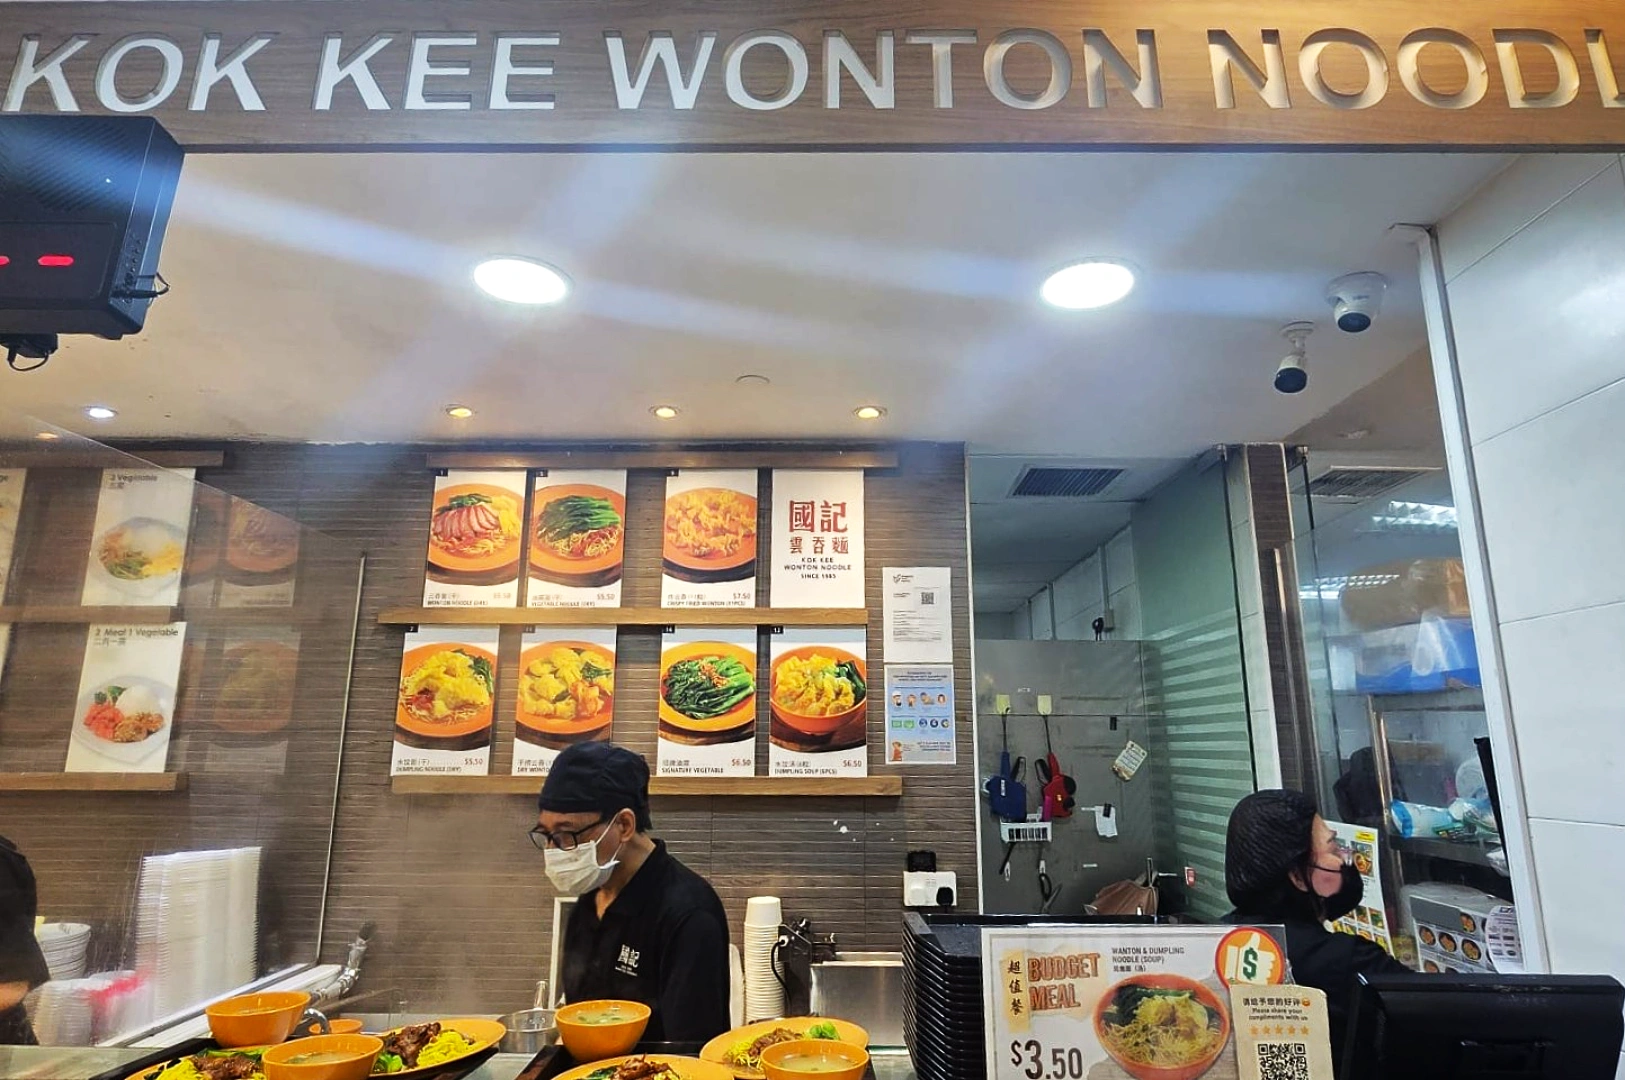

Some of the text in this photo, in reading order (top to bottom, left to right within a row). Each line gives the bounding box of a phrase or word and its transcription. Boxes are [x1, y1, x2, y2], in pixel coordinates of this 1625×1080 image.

[3, 33, 279, 112] KOK
[312, 31, 562, 111] KEE
[604, 28, 1162, 111] WONTON
[789, 500, 848, 533] 國記
[104, 628, 127, 636] Meat
[136, 628, 179, 638] Vegetable
[842, 759, 863, 768] $6.50
[1027, 953, 1100, 982] BUDGET
[1141, 956, 1164, 964] (SOUP)
[1029, 983, 1081, 1011] MEAL
[1011, 1040, 1083, 1080] $3.50
